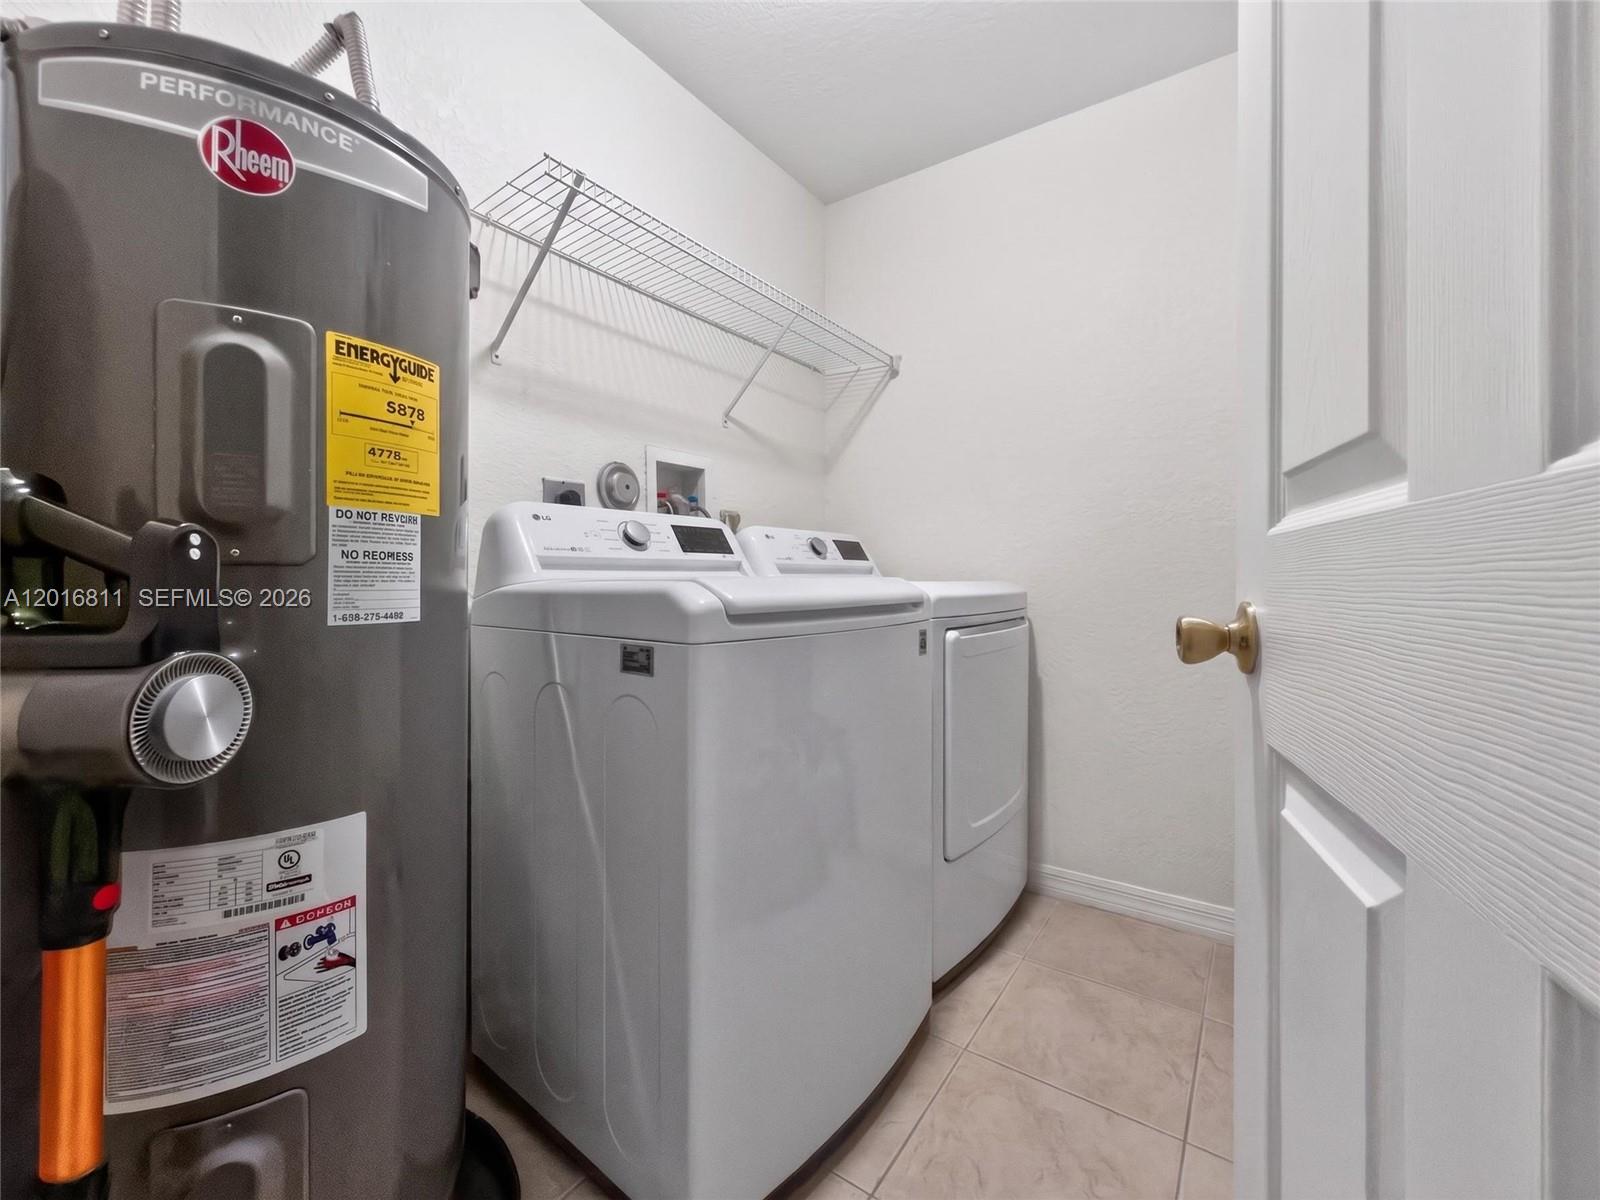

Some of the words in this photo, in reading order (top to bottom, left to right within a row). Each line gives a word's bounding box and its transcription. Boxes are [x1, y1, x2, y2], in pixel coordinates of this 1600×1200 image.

[140, 72, 354, 153] PERFORMANCE
[211, 120, 290, 184] Rheem
[335, 339, 435, 384] ENERGYGUIDE
[368, 447, 402, 461] 4778
[335, 509, 353, 519] DO
[356, 510, 378, 521] NOT
[341, 549, 359, 560] NO
